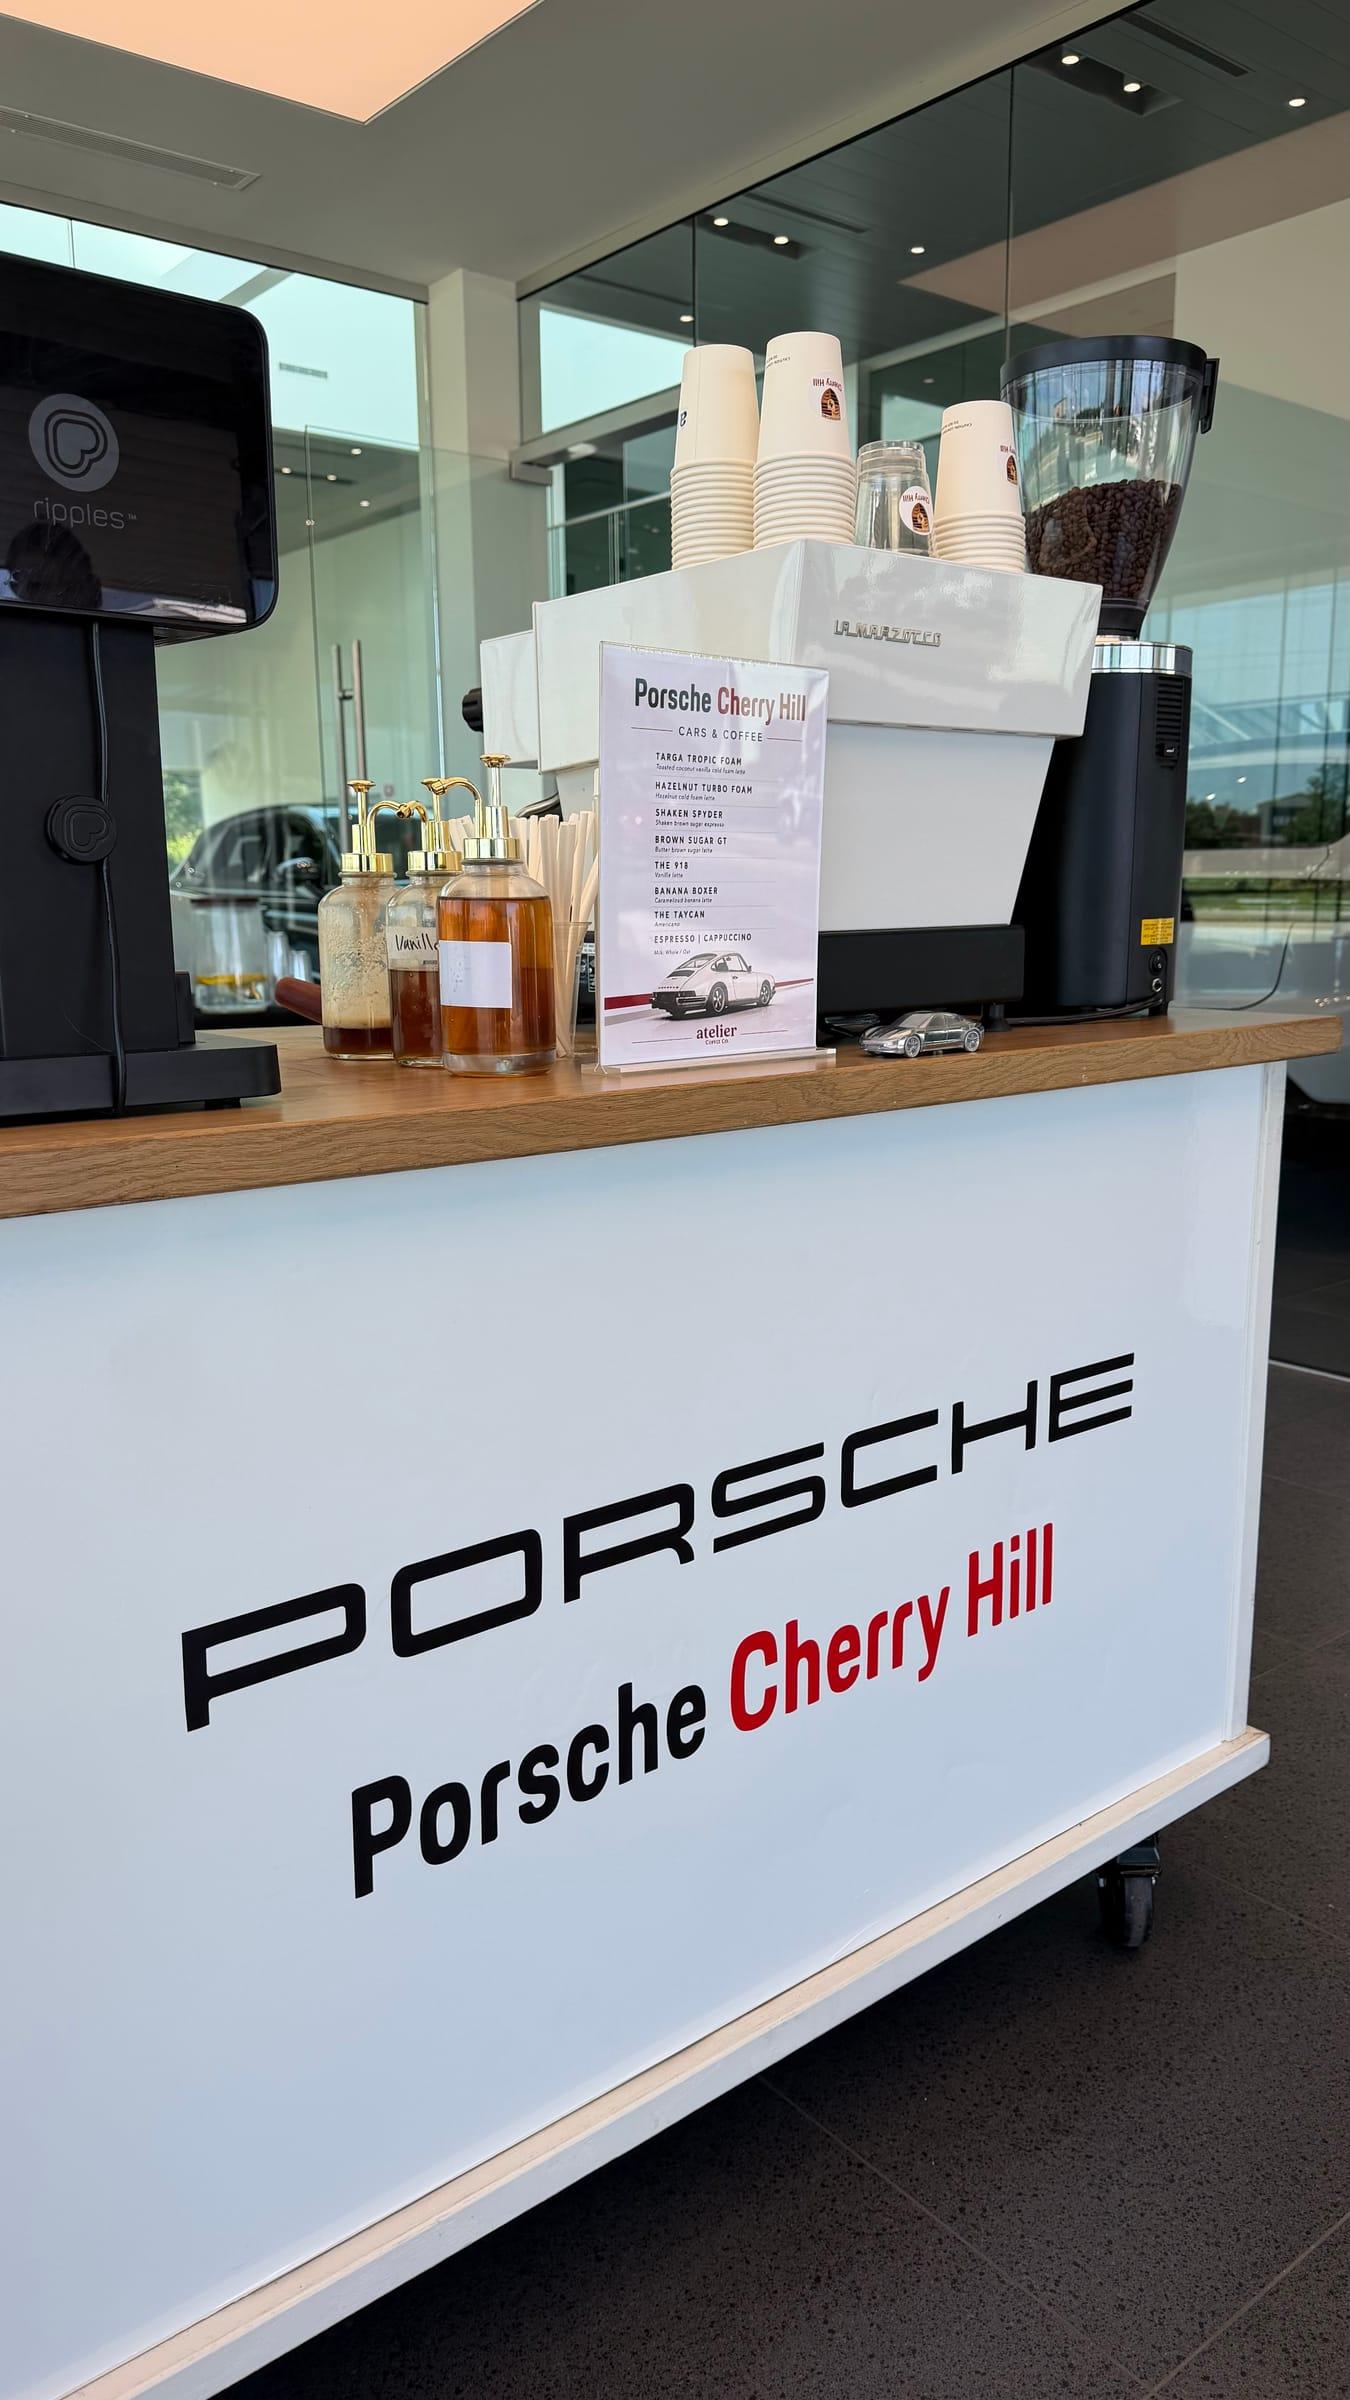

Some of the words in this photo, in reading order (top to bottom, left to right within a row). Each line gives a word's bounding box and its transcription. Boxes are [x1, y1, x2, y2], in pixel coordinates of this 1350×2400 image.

[812, 378, 824, 387] Hill
[902, 494, 914, 502] Hill
[34, 497, 124, 529] ripples
[635, 678, 712, 713] Porsche
[717, 686, 776, 725] Cherry
[780, 693, 806, 721] Hill
[678, 726, 707, 738] CARS
[712, 729, 718, 738] &
[723, 730, 764, 742] COFFEE
[656, 752, 684, 762] TARGA
[688, 754, 717, 764] TROPIC
[720, 756, 742, 766] FOAM
[656, 781, 698, 792] HAZELNUT
[702, 784, 728, 793] TURBO
[731, 786, 752, 795] FOAM
[656, 808, 688, 818] SHAKEN
[692, 810, 724, 819] SPYDER
[655, 836, 684, 844] BROWN
[688, 836, 714, 845] SUGAR
[718, 837, 727, 845] GT
[654, 862, 670, 870] THE
[674, 862, 688, 870] 918
[654, 887, 688, 895] BANANA
[692, 886, 718, 895] BOXER
[674, 910, 704, 918] TAYCAN
[654, 934, 695, 944] ESPRESSO
[704, 933, 752, 942] CAPPUCCINO
[696, 1024, 738, 1040] atelier
[181, 1352, 1135, 1732] PORSCHE
[351, 1682, 706, 1898] Porsche
[729, 1586, 949, 1732] Cherry
[967, 1522, 1055, 1637] Hill
